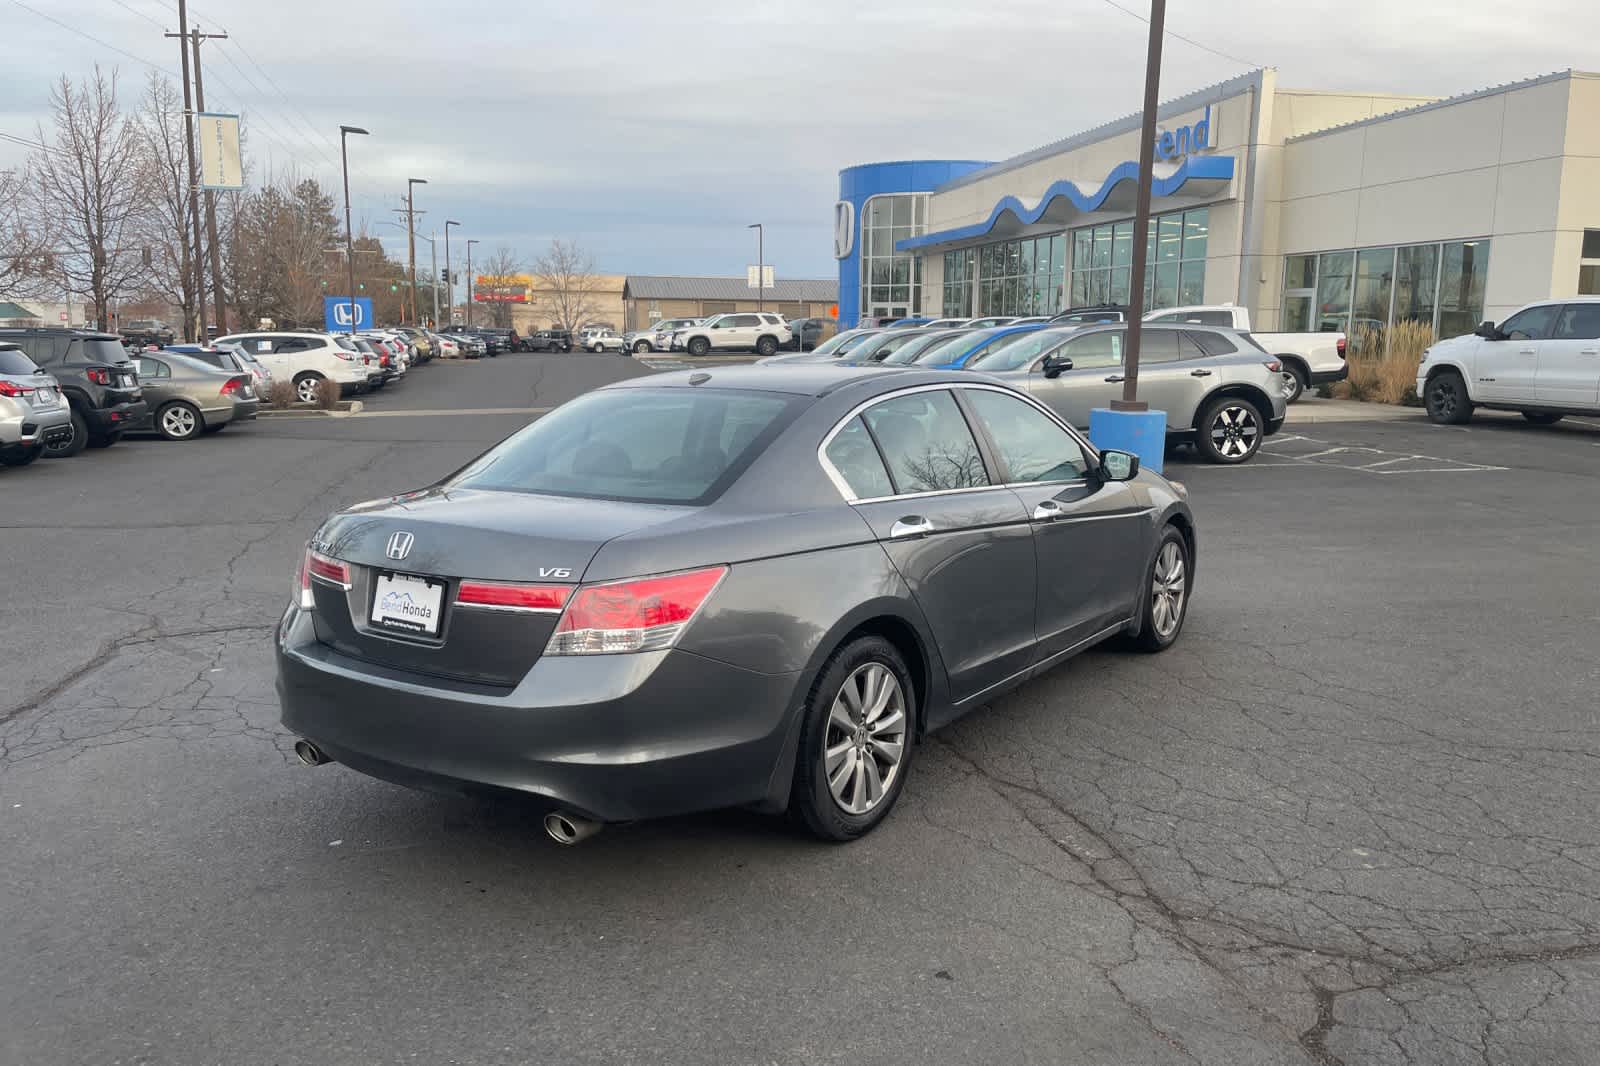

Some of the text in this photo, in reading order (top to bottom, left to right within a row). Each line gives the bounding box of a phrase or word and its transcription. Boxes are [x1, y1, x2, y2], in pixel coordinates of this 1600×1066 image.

[1154, 104, 1211, 160] end
[539, 567, 573, 578] V6
[402, 601, 432, 618] Honda
